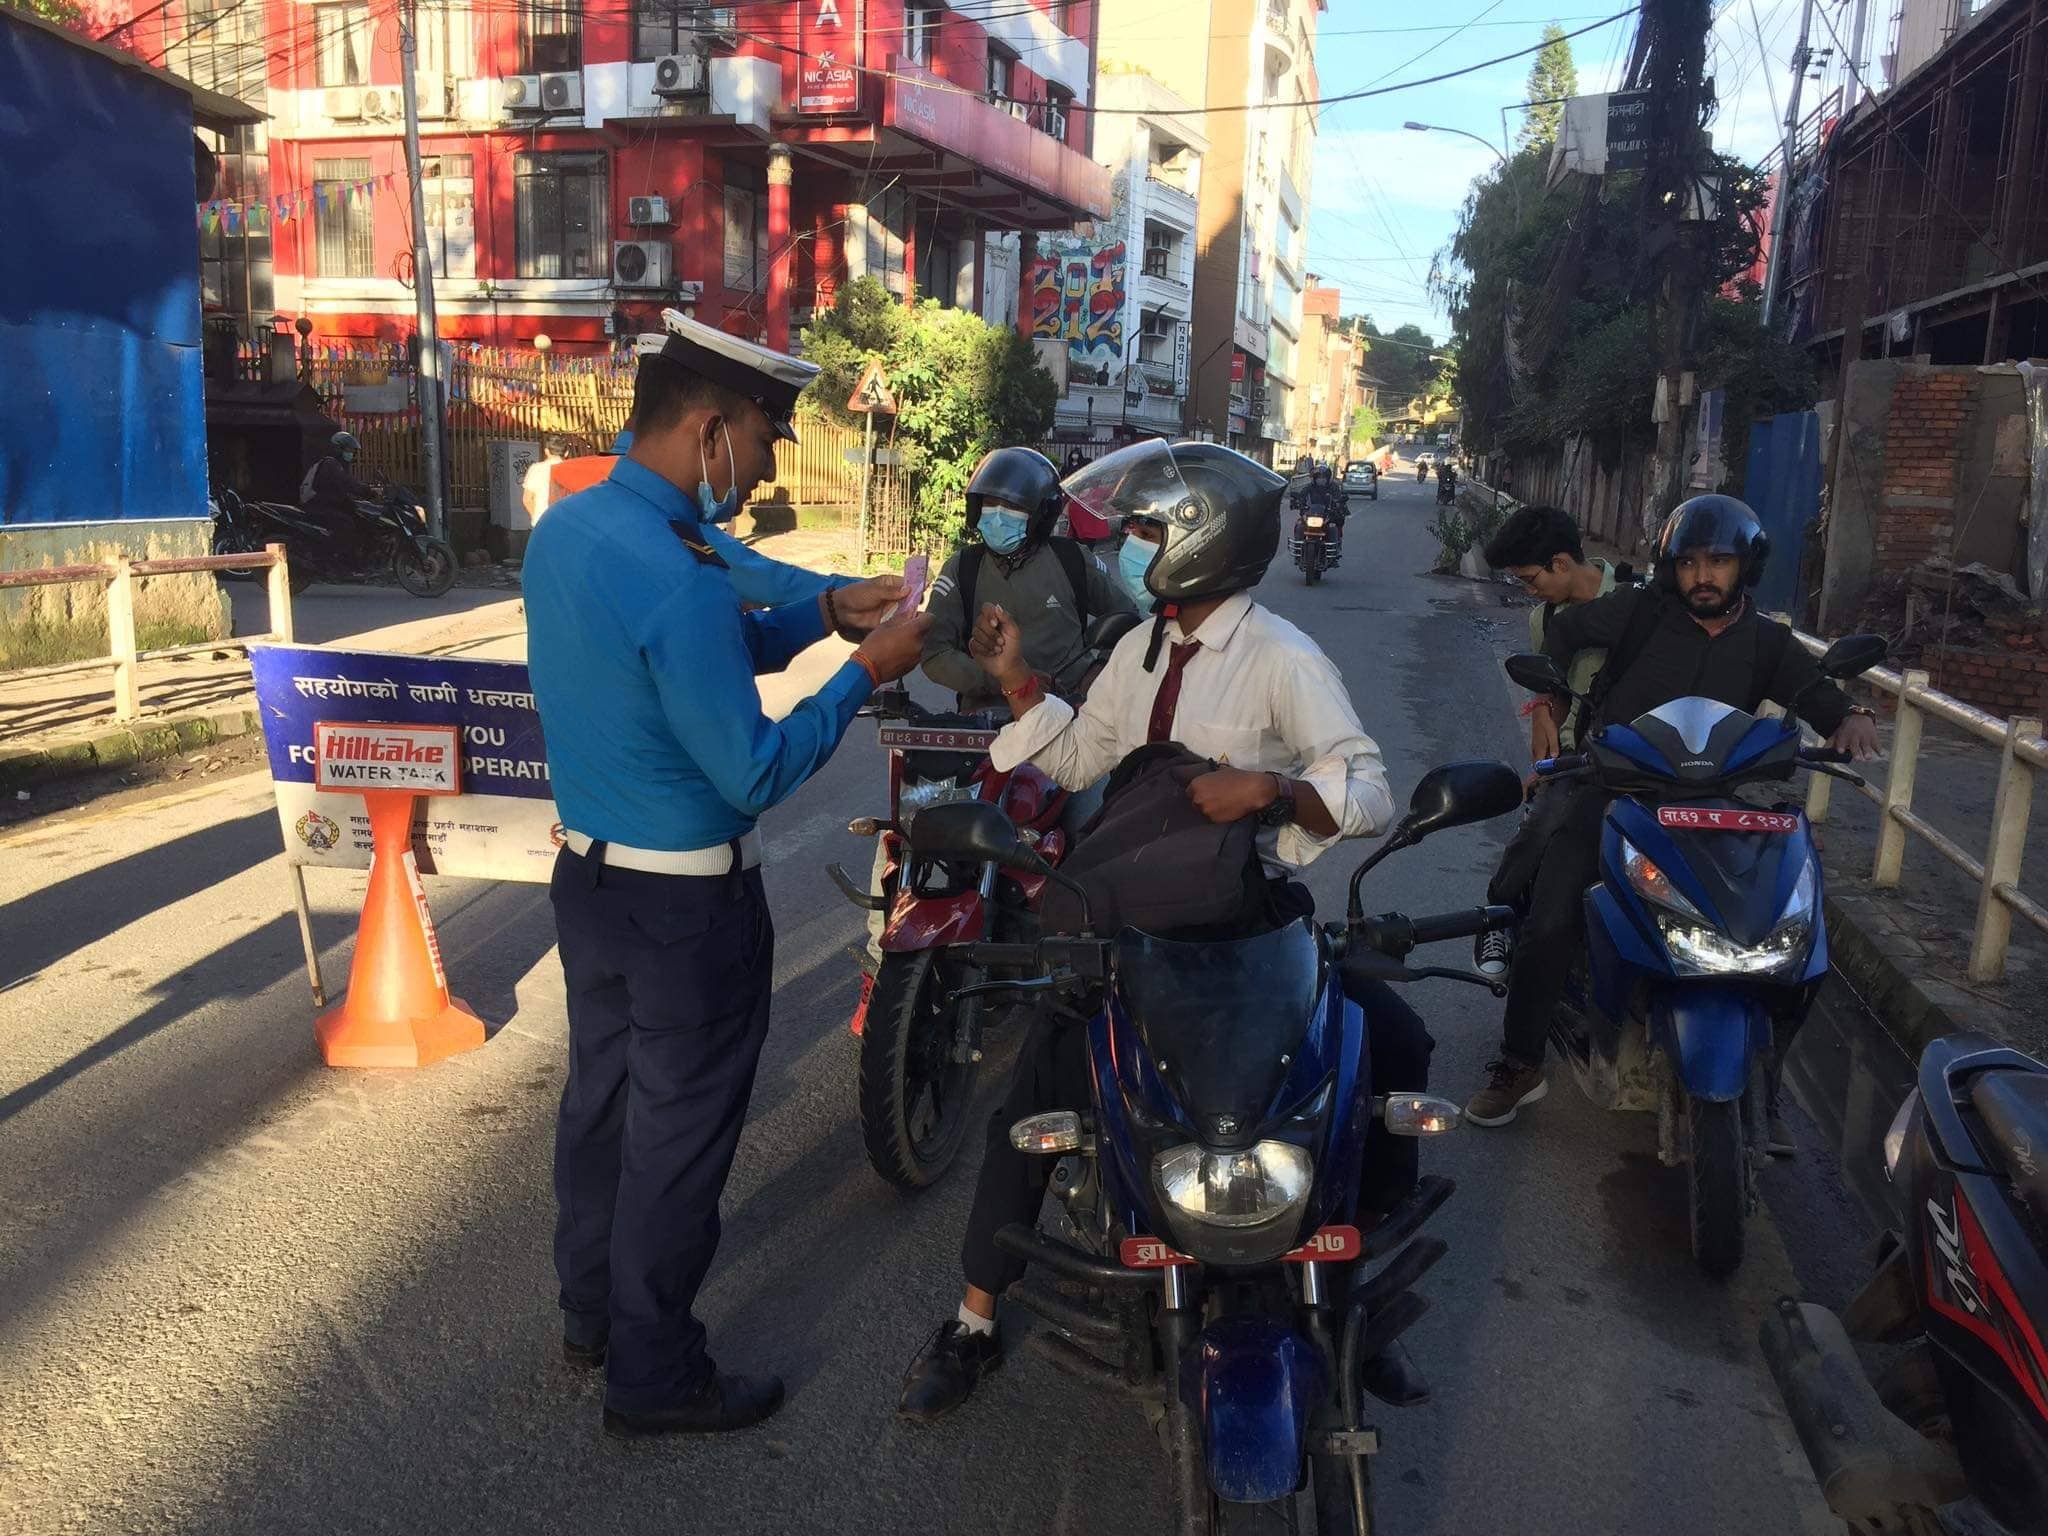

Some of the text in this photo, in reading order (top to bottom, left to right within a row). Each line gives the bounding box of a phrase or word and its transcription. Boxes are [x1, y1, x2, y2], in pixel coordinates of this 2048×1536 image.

[804, 69, 854, 83] NIC ASIA
[293, 675, 399, 700] सहयोगको
[466, 688, 536, 711] धन्यवा
[289, 745, 316, 763] FO
[325, 734, 444, 763] Hilltake
[329, 764, 445, 782] WATER TAK
[1680, 760, 1714, 768] HONDA
